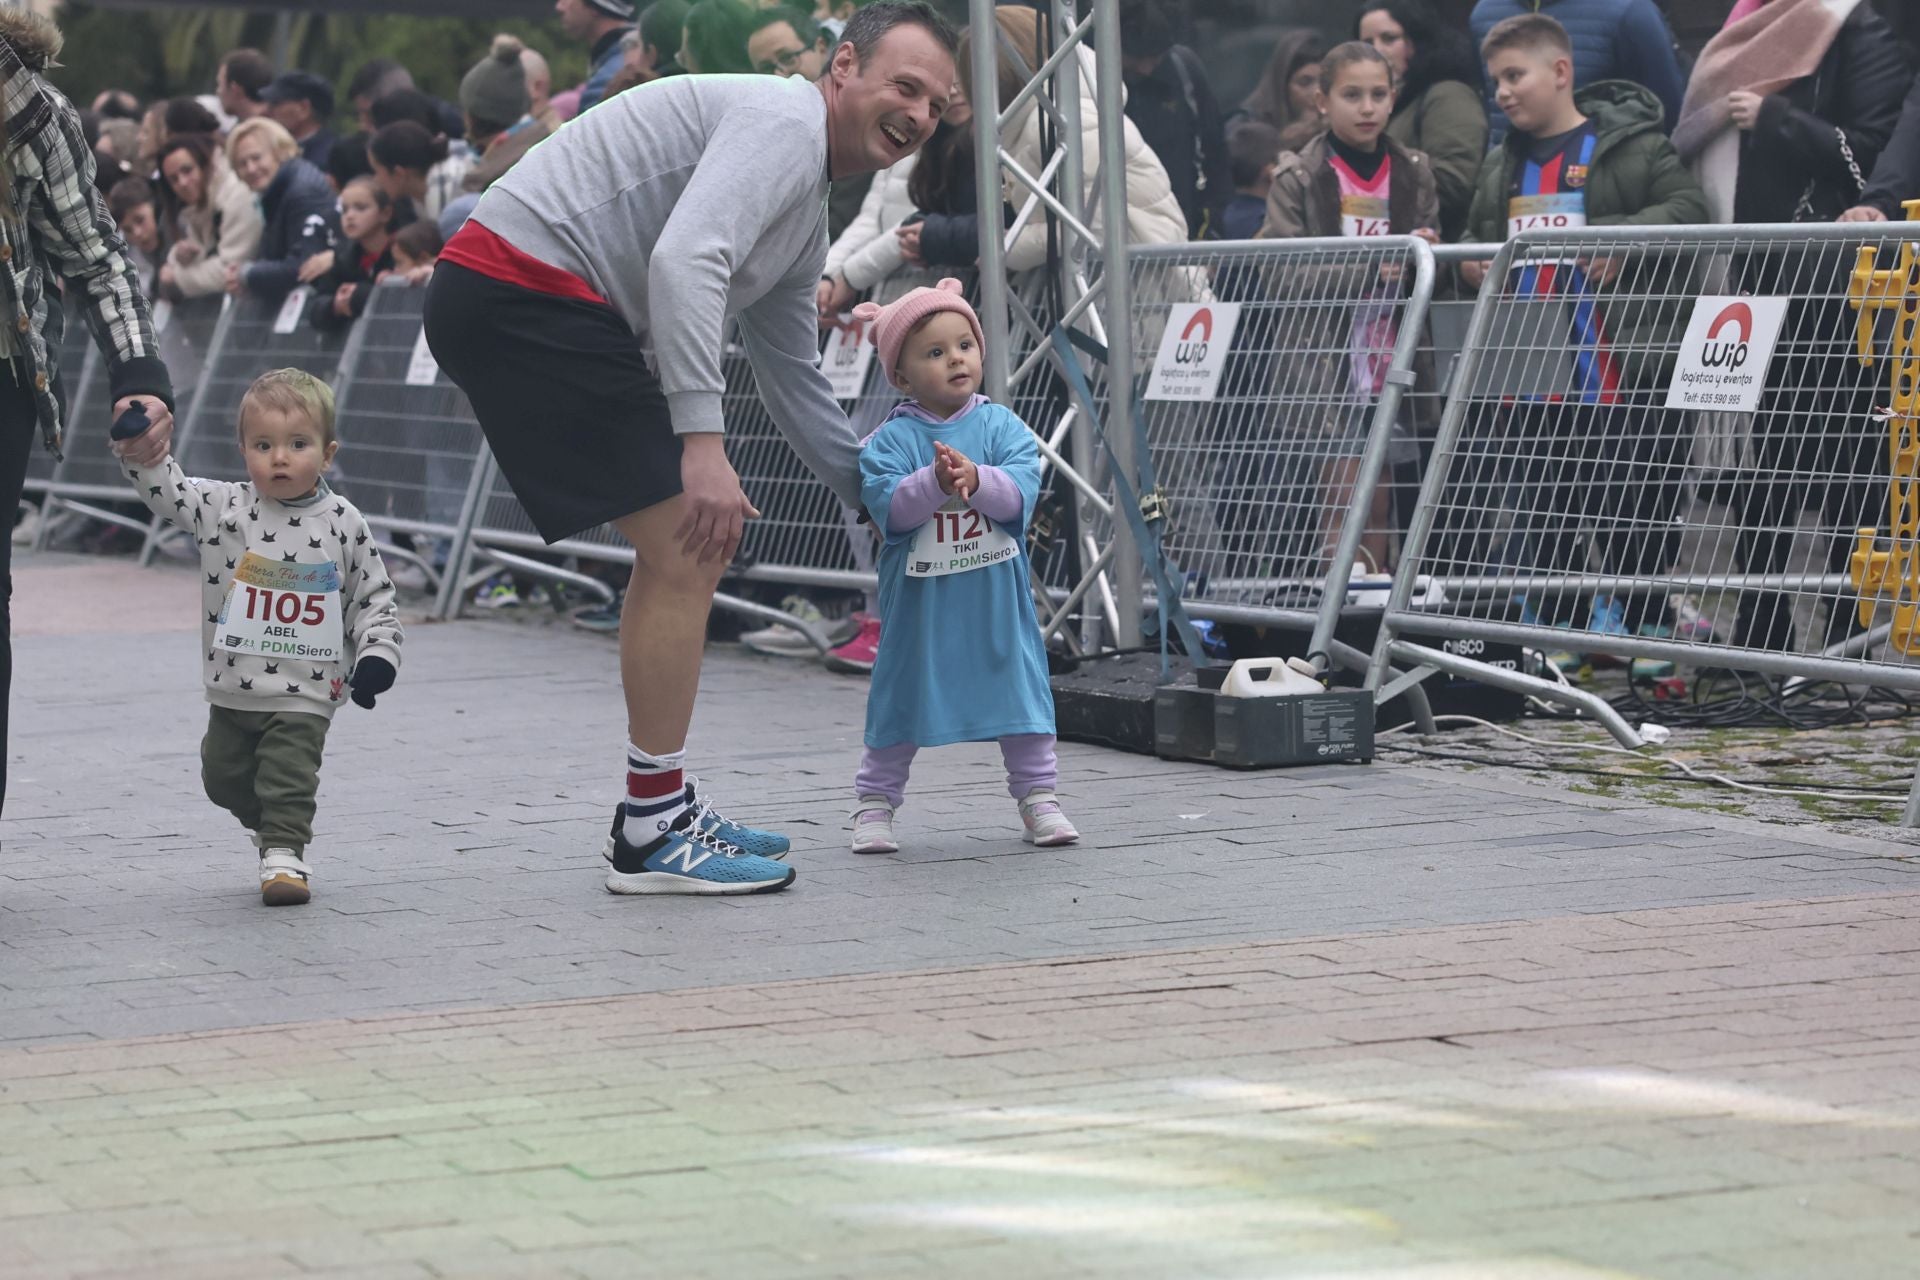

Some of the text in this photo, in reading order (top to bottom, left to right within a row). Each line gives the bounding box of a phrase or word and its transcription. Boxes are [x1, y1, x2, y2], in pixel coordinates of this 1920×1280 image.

[1175, 343, 1208, 368] wip
[1701, 343, 1748, 373] wip
[1715, 375, 1722, 388] y
[1723, 373, 1752, 386] eventos
[953, 541, 978, 554] TIKII
[949, 547, 1011, 570] PDMSiero
[246, 586, 325, 626] 1105
[264, 625, 298, 638] ABEL
[261, 640, 332, 656] PDMSiero
